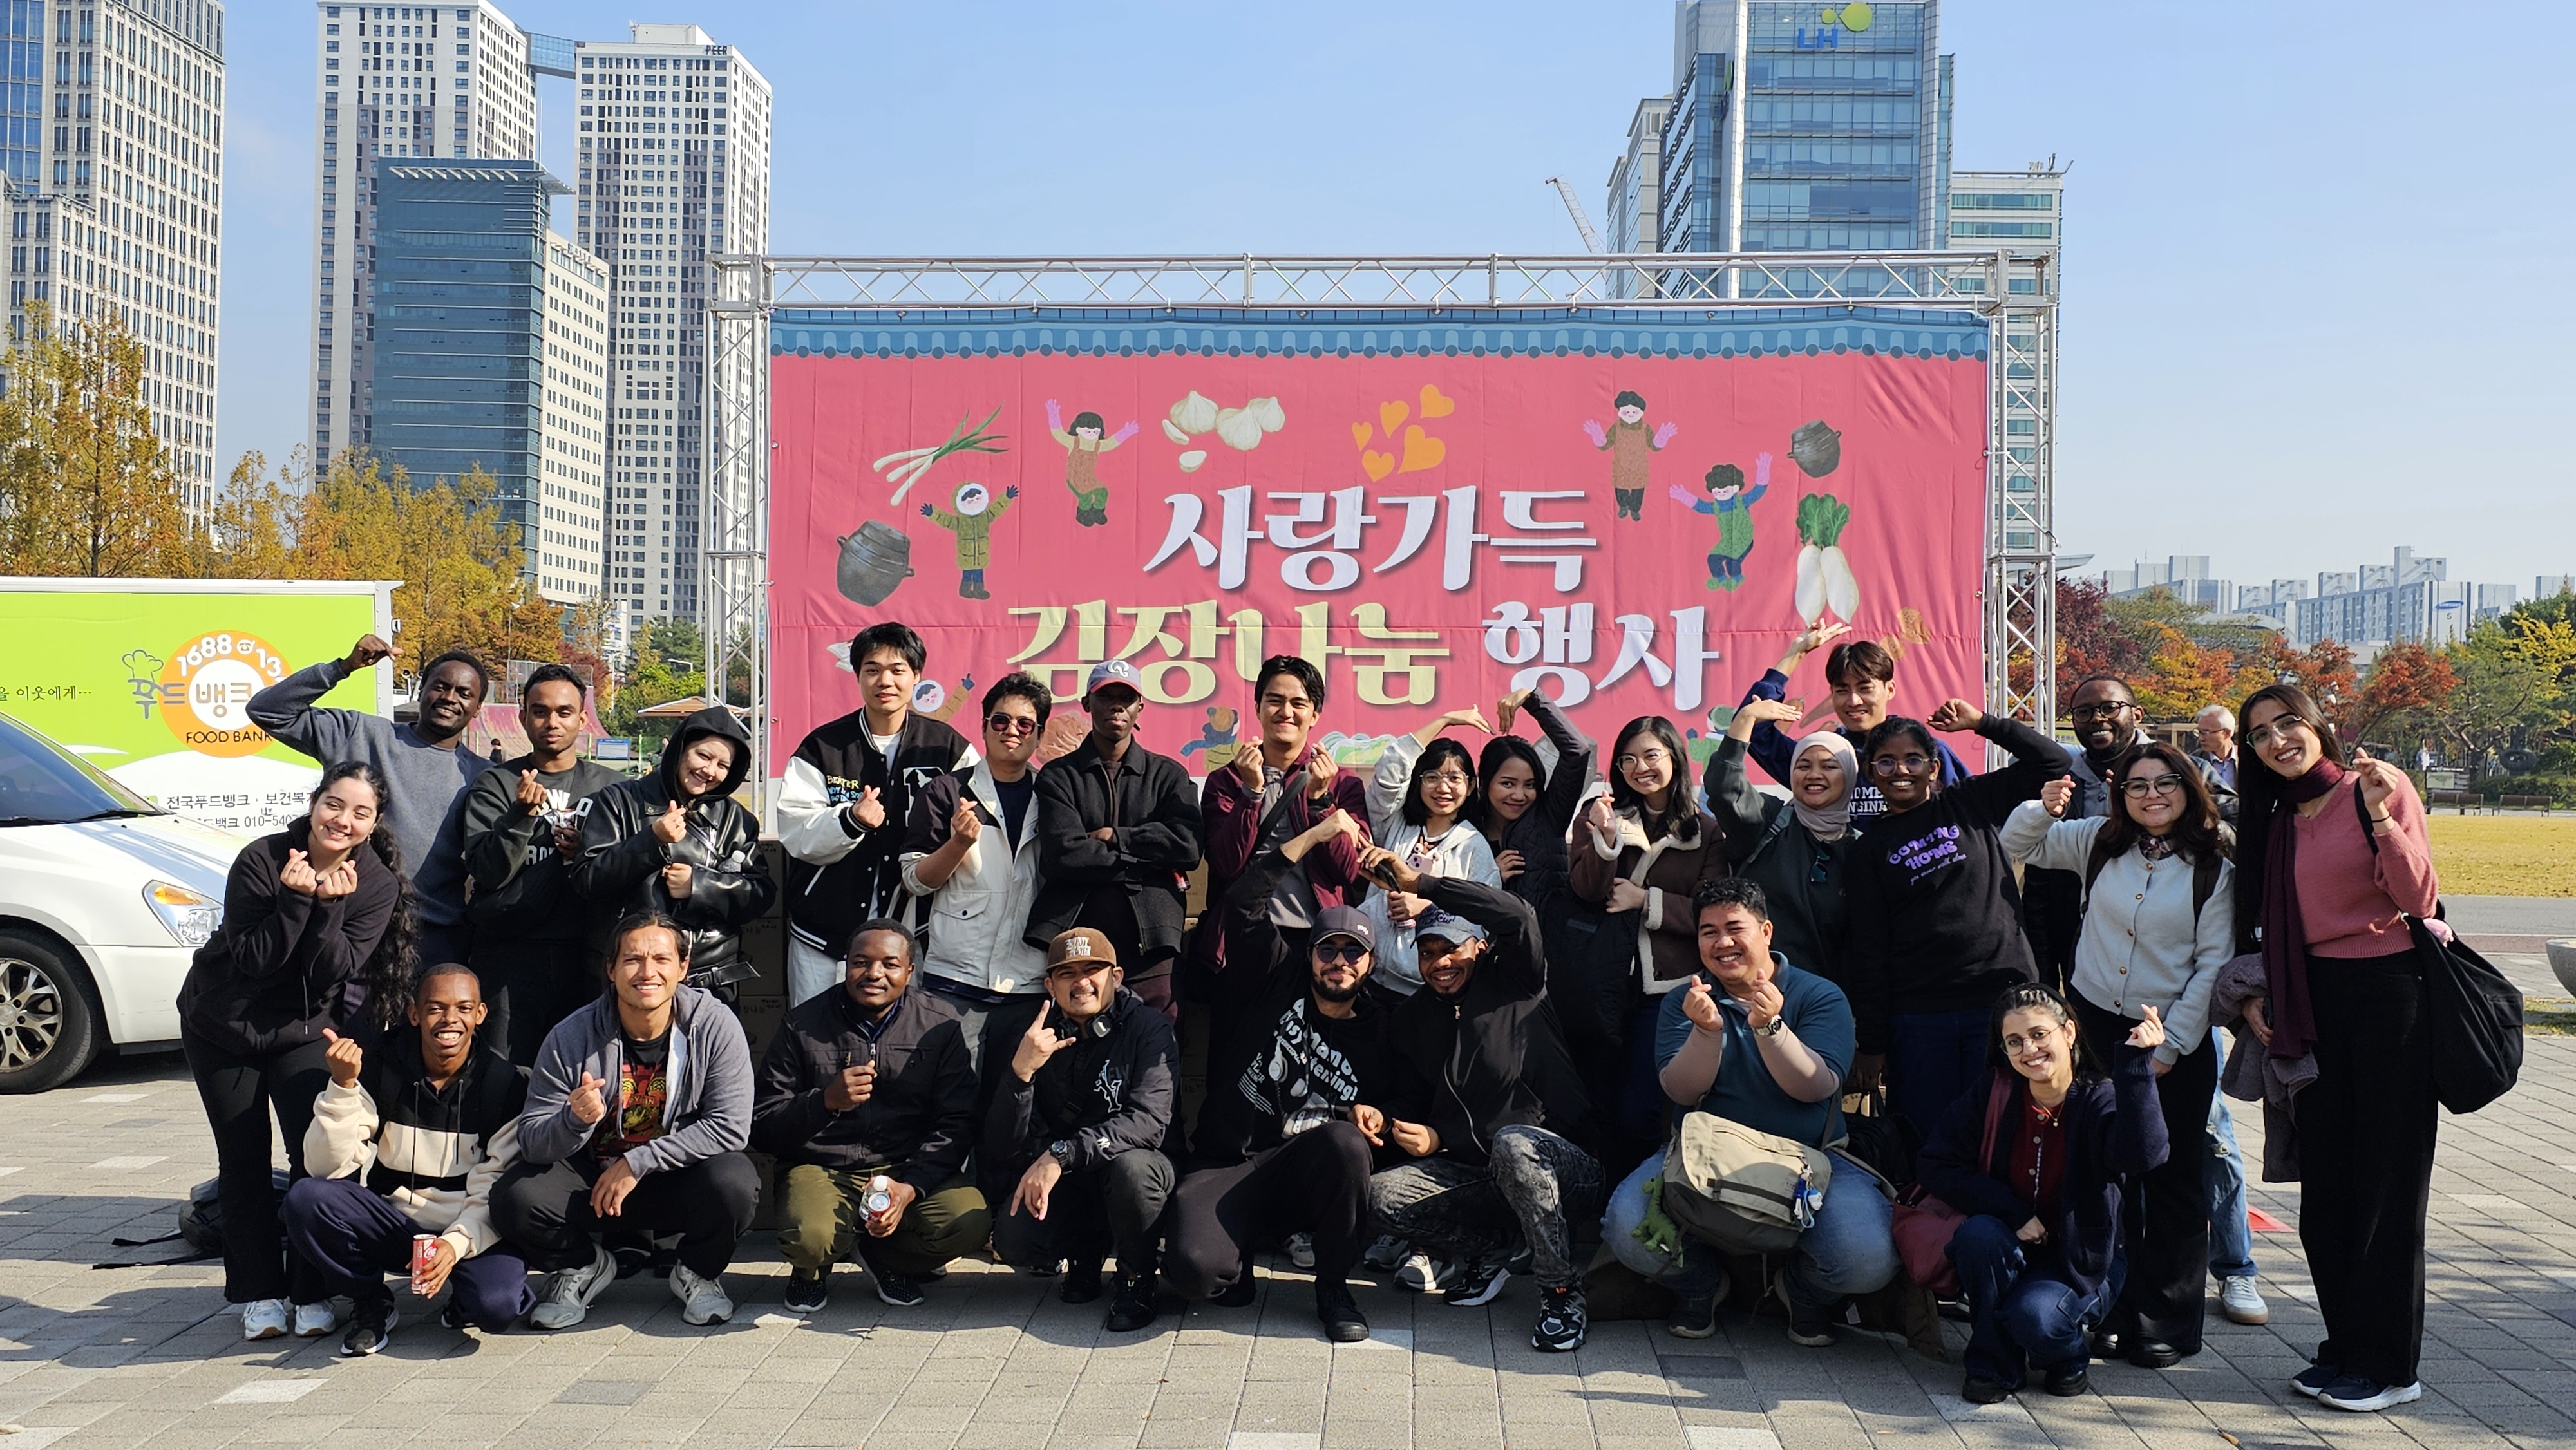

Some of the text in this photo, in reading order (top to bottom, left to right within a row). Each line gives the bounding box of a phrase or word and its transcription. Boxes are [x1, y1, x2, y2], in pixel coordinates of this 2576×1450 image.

[705, 44, 728, 55] PEER
[1797, 28, 1838, 48] LH
[1143, 484, 1598, 592] 사랑가득
[176, 634, 232, 677] 1688
[1006, 599, 1719, 711] 김장나눔 행사
[186, 731, 229, 744] FOOD
[166, 794, 251, 810] 전국푸드뱅크
[1889, 825, 1960, 864] COMING
